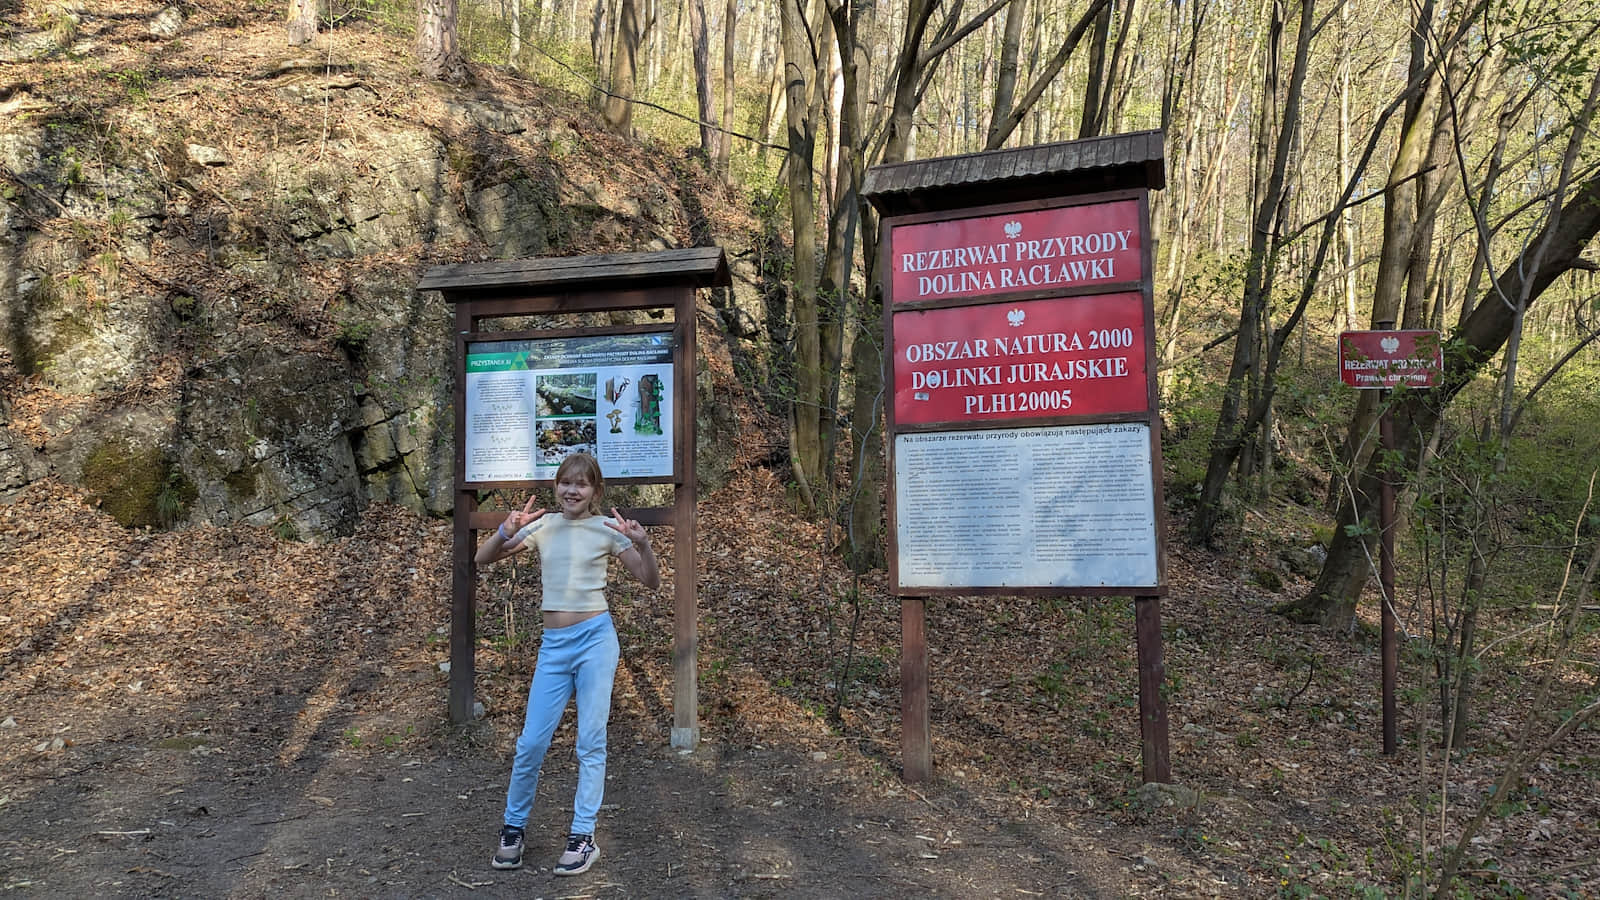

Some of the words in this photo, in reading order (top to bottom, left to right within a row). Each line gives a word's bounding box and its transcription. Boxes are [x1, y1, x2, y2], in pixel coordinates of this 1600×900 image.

[902, 243, 1010, 273] REZERWAT
[1016, 229, 1132, 260] PRZYRODY
[918, 271, 996, 297] DOLINA
[1000, 257, 1116, 288] RACŁAWKI
[905, 339, 989, 364] OBSZAR
[994, 332, 1084, 356] NATURA
[1088, 327, 1134, 350] 2000
[912, 366, 1002, 390] DOLINKI
[1006, 357, 1129, 384] JURAJSKIE
[1344, 359, 1389, 370] REZERWAT
[1388, 374, 1427, 383] chrniony
[964, 389, 1073, 415] PLH120005
[903, 436, 914, 444] Na
[914, 434, 946, 443] obszarze
[948, 433, 984, 441] rezerwatu
[985, 431, 1019, 441] przyrody
[1020, 429, 1064, 439] obowiązują
[1065, 426, 1112, 437] następujące
[1114, 424, 1144, 434] zakazy:
